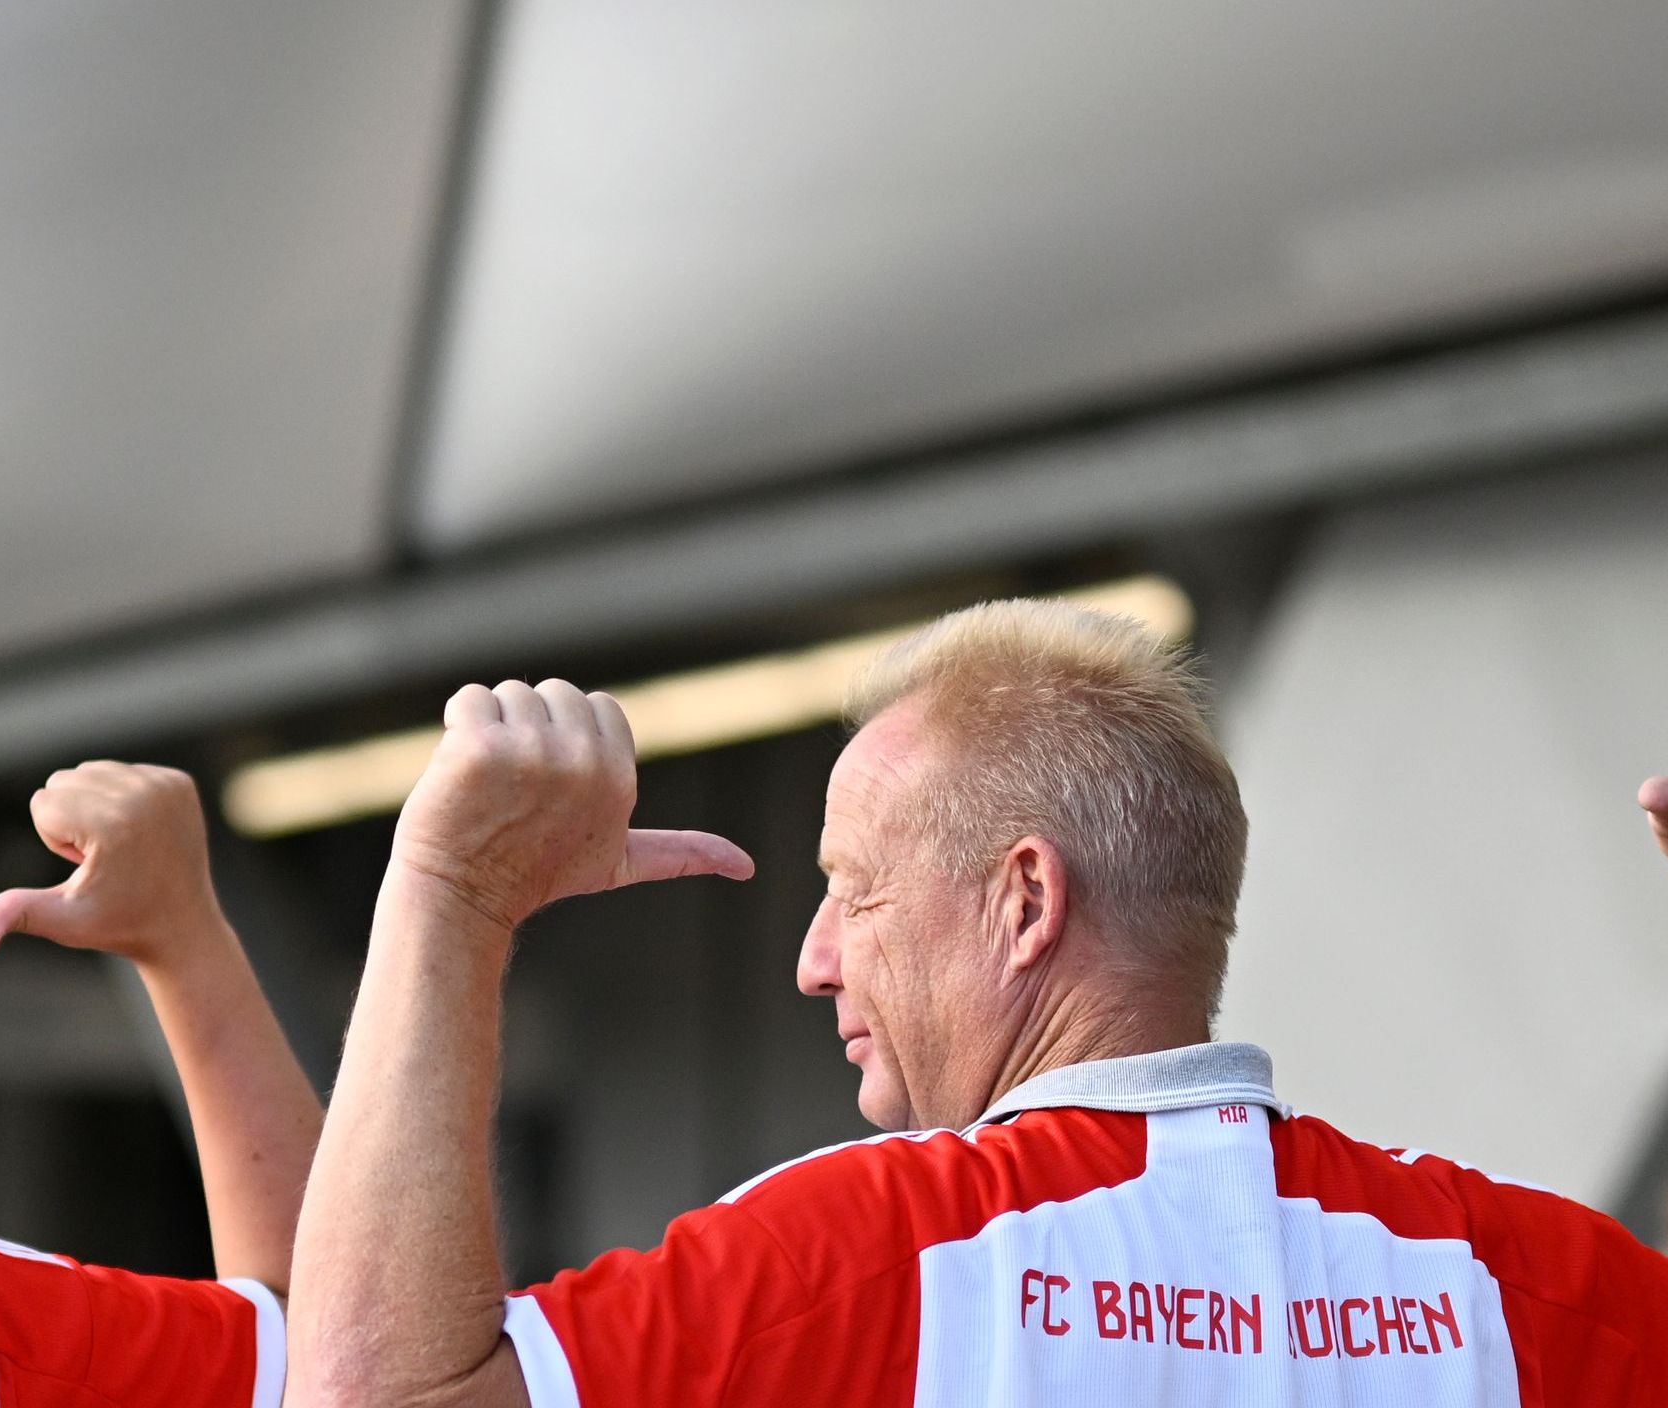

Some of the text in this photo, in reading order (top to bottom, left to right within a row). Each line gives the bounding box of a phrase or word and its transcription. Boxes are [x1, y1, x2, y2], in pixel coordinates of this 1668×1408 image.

[1218, 1105, 1248, 1123] MIA
[1021, 1268, 1464, 1359] FC BAYERN ÜCHEN
